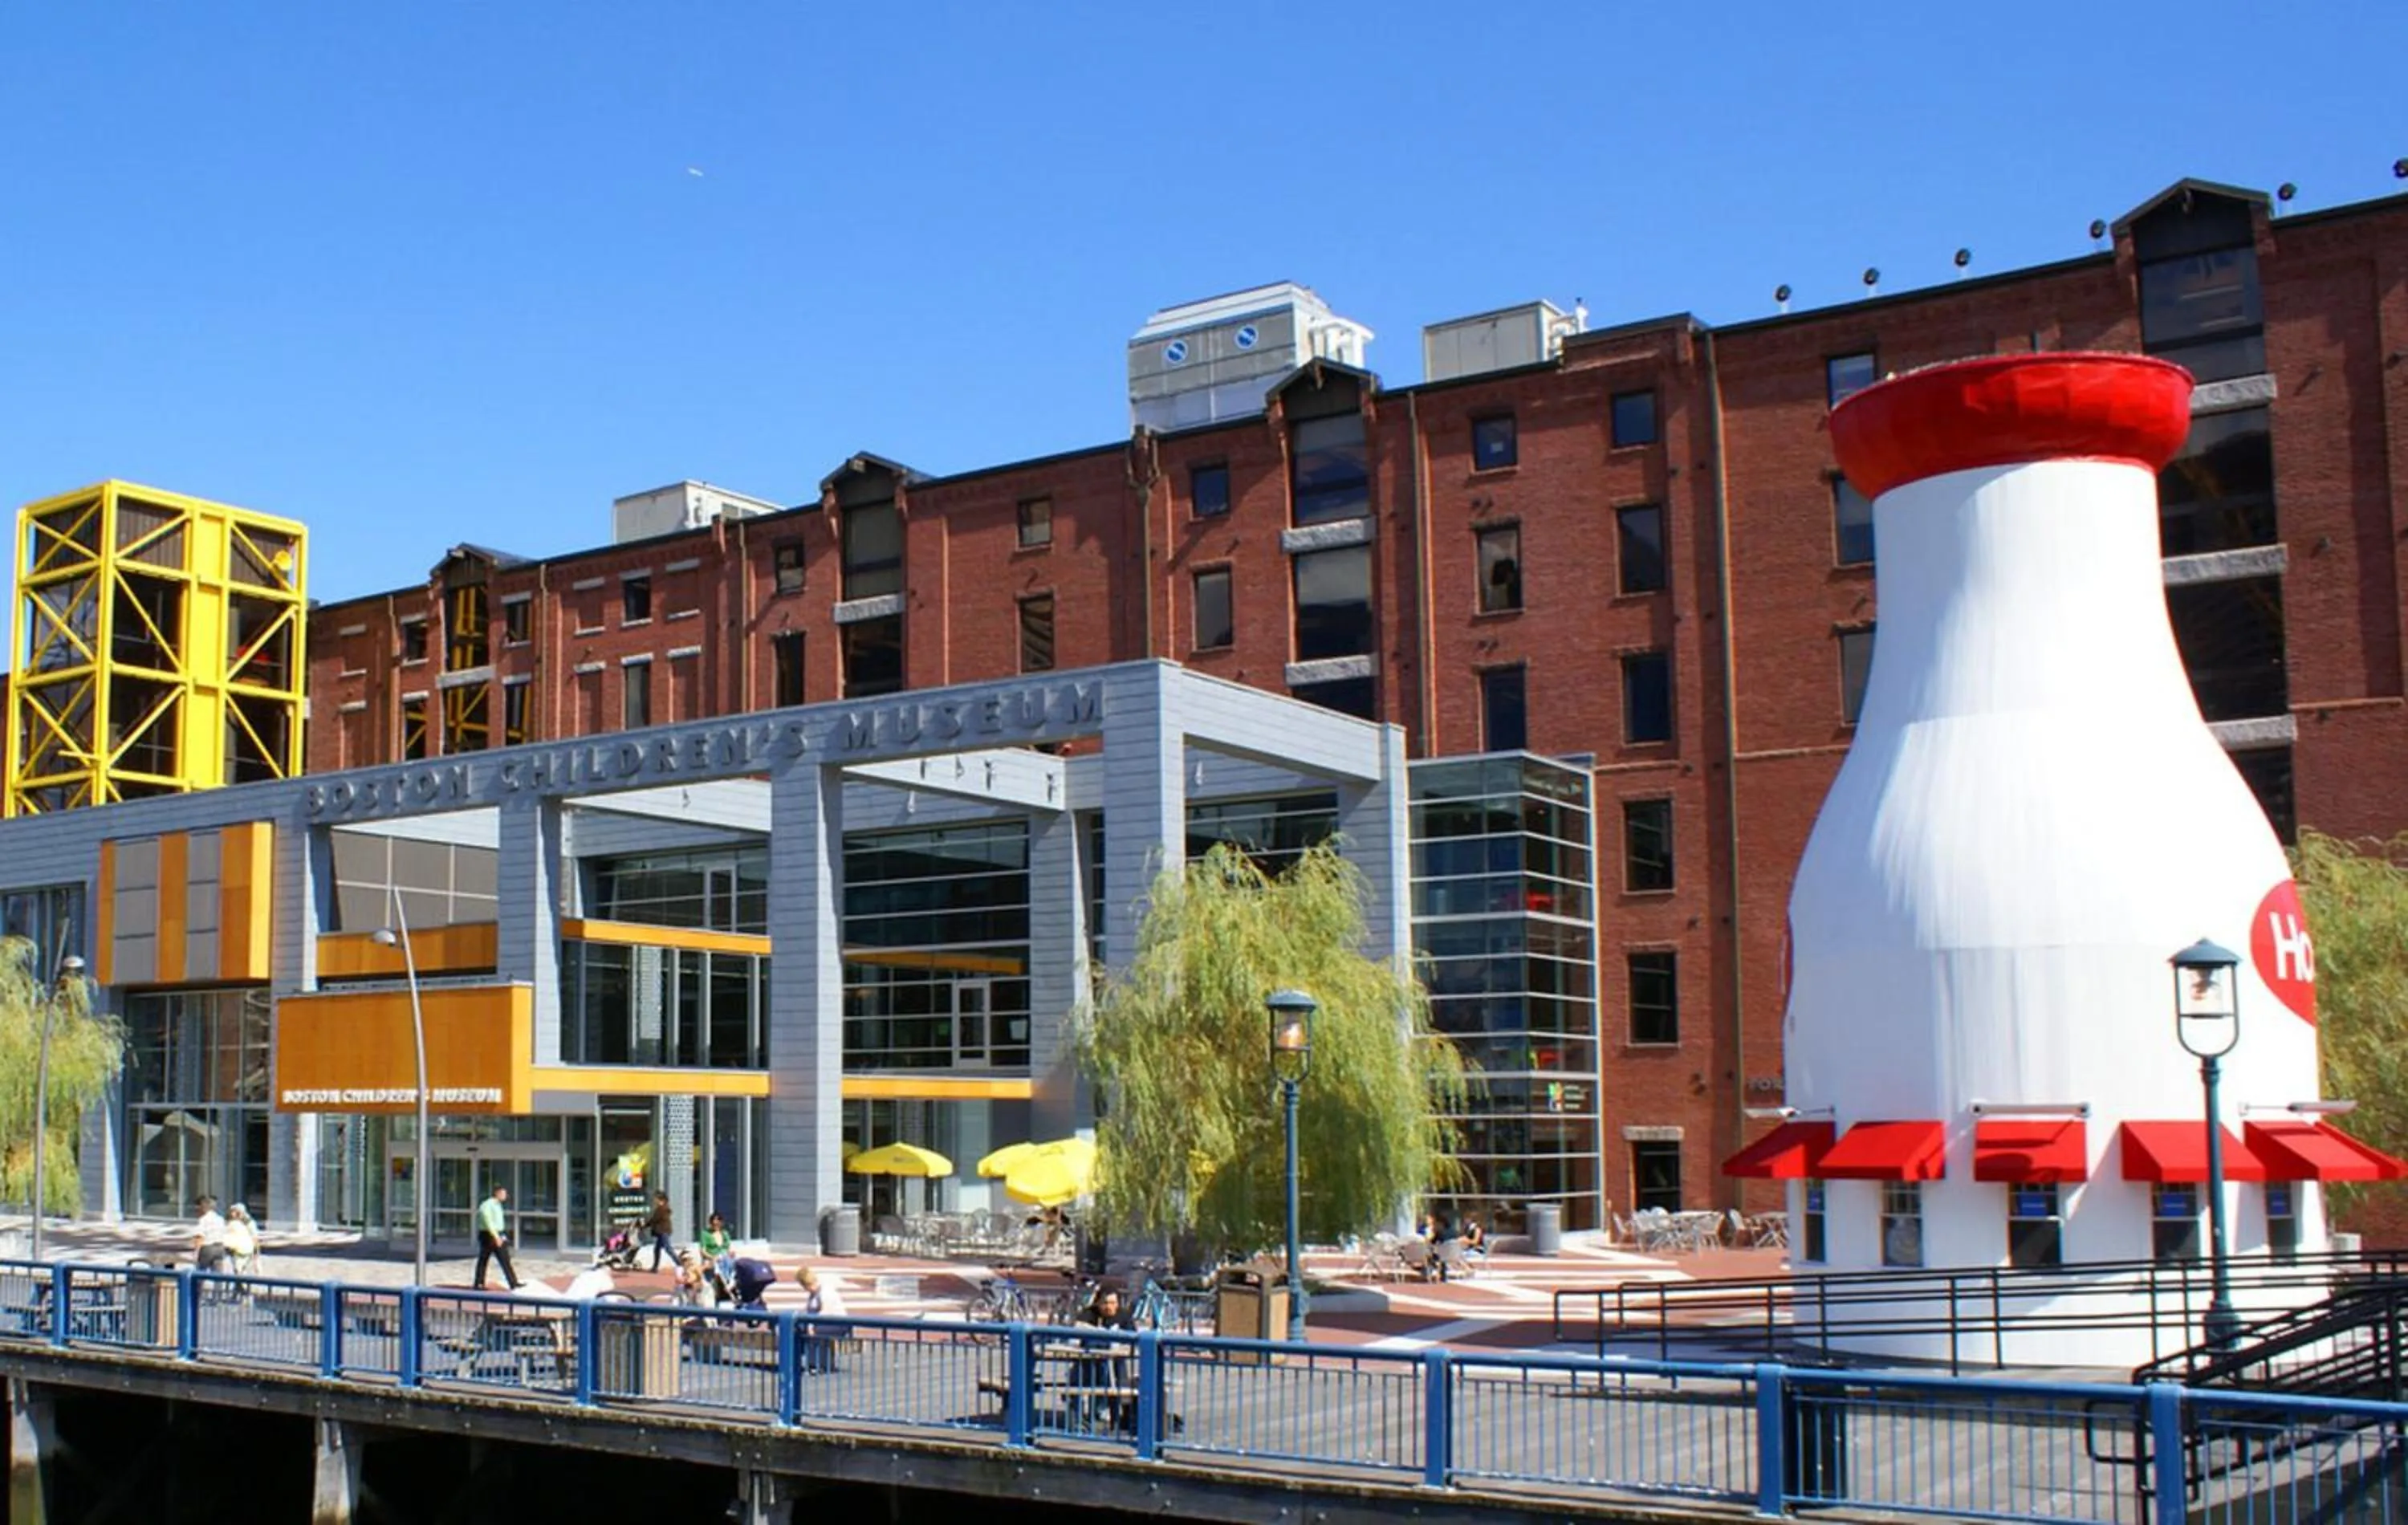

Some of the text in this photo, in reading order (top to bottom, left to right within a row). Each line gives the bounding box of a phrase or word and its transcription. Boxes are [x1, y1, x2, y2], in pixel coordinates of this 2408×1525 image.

[305, 681, 1104, 816] BOSTON CHILDREN'S MUSEUM
[283, 1089, 340, 1104] BOSTON
[432, 1088, 502, 1103] MUSEUM
